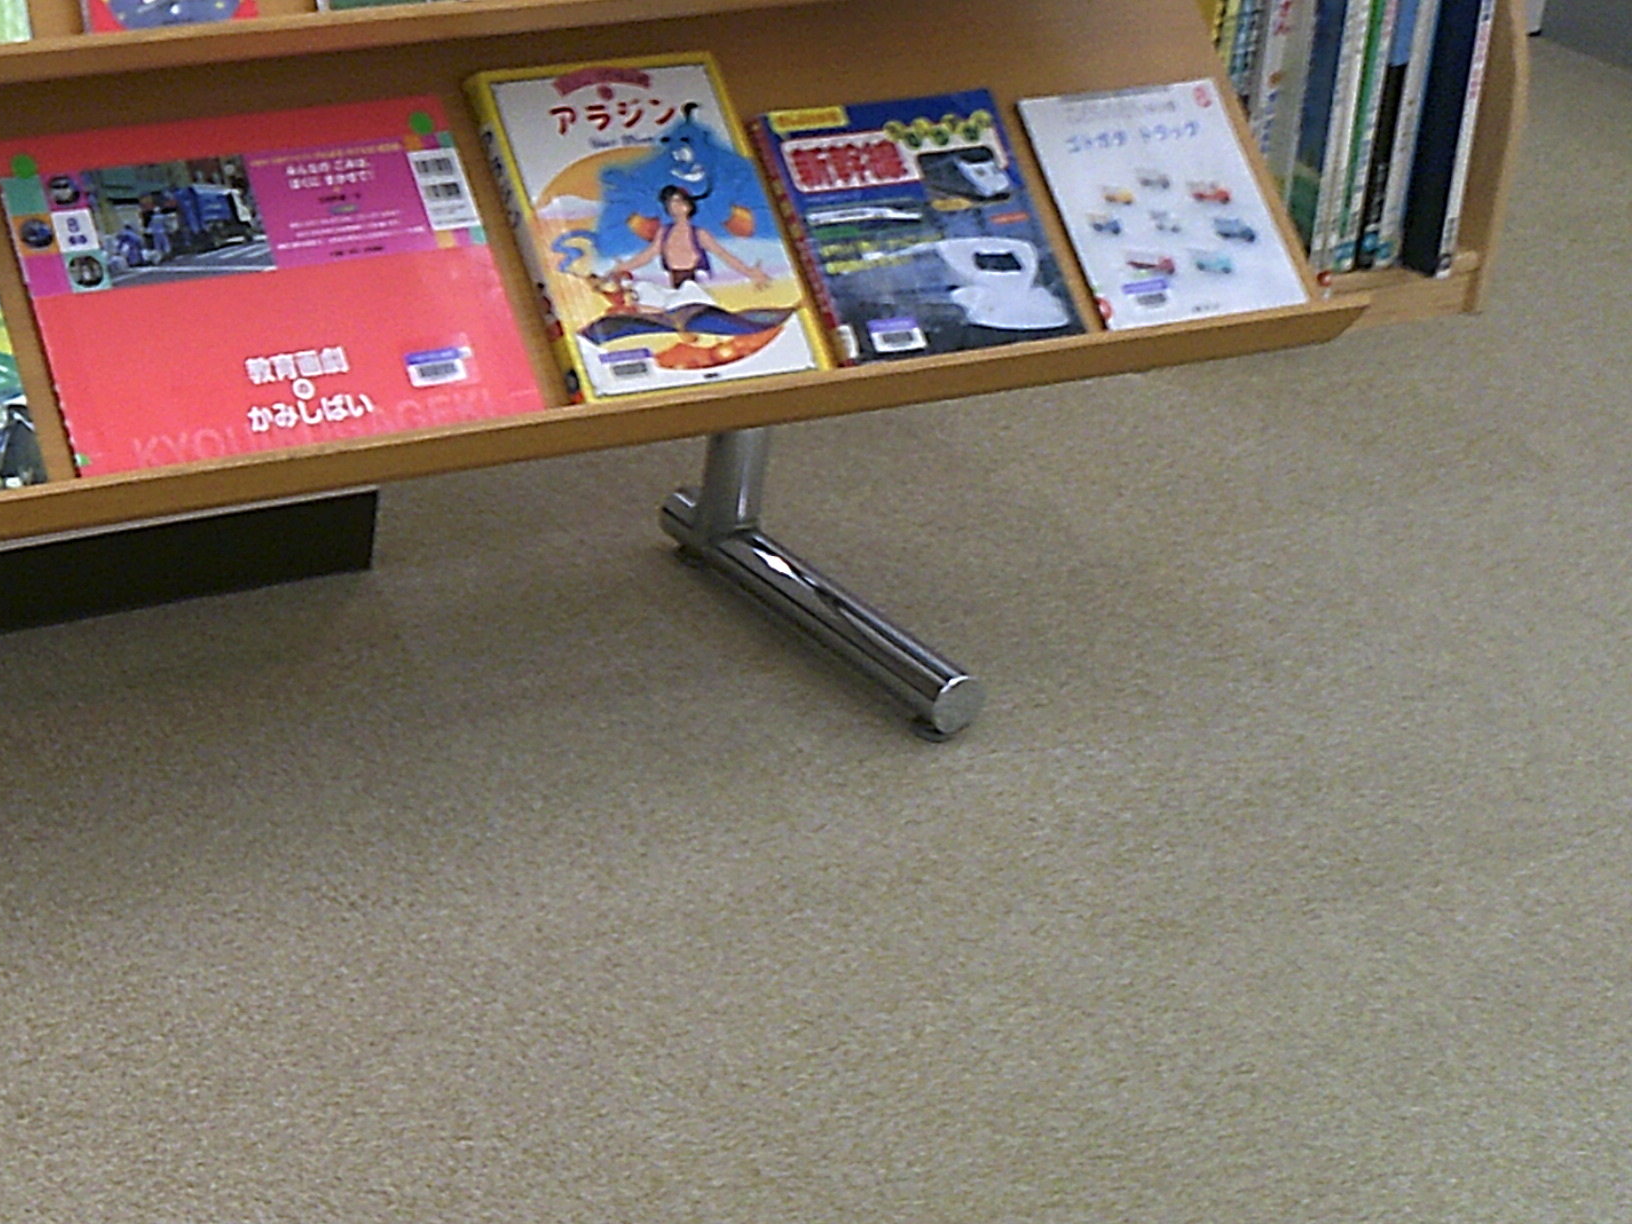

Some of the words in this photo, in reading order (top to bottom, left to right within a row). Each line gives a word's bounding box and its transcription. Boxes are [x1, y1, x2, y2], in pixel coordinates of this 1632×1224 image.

[549, 98, 679, 136] アラジン
[244, 347, 351, 384] 教育画劇
[247, 394, 376, 433] かみしばい
